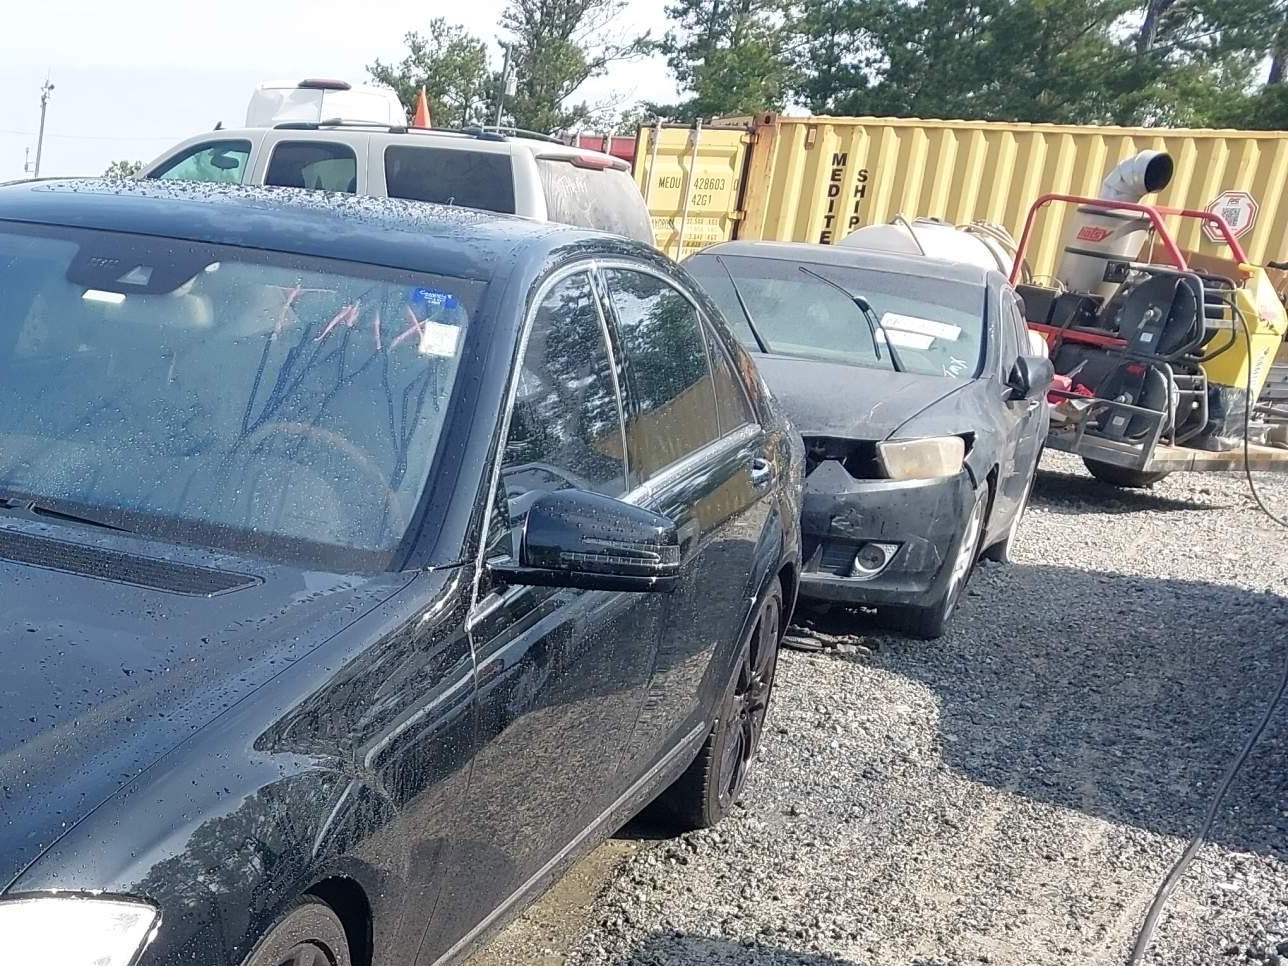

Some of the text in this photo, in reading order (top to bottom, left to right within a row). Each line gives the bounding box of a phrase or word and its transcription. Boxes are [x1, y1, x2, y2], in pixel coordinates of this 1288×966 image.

[658, 176, 681, 189] MEDU
[694, 178, 726, 191] 428603
[691, 194, 712, 206] 42G1
[819, 153, 848, 245] MEDITE
[847, 169, 869, 236] SHIP
